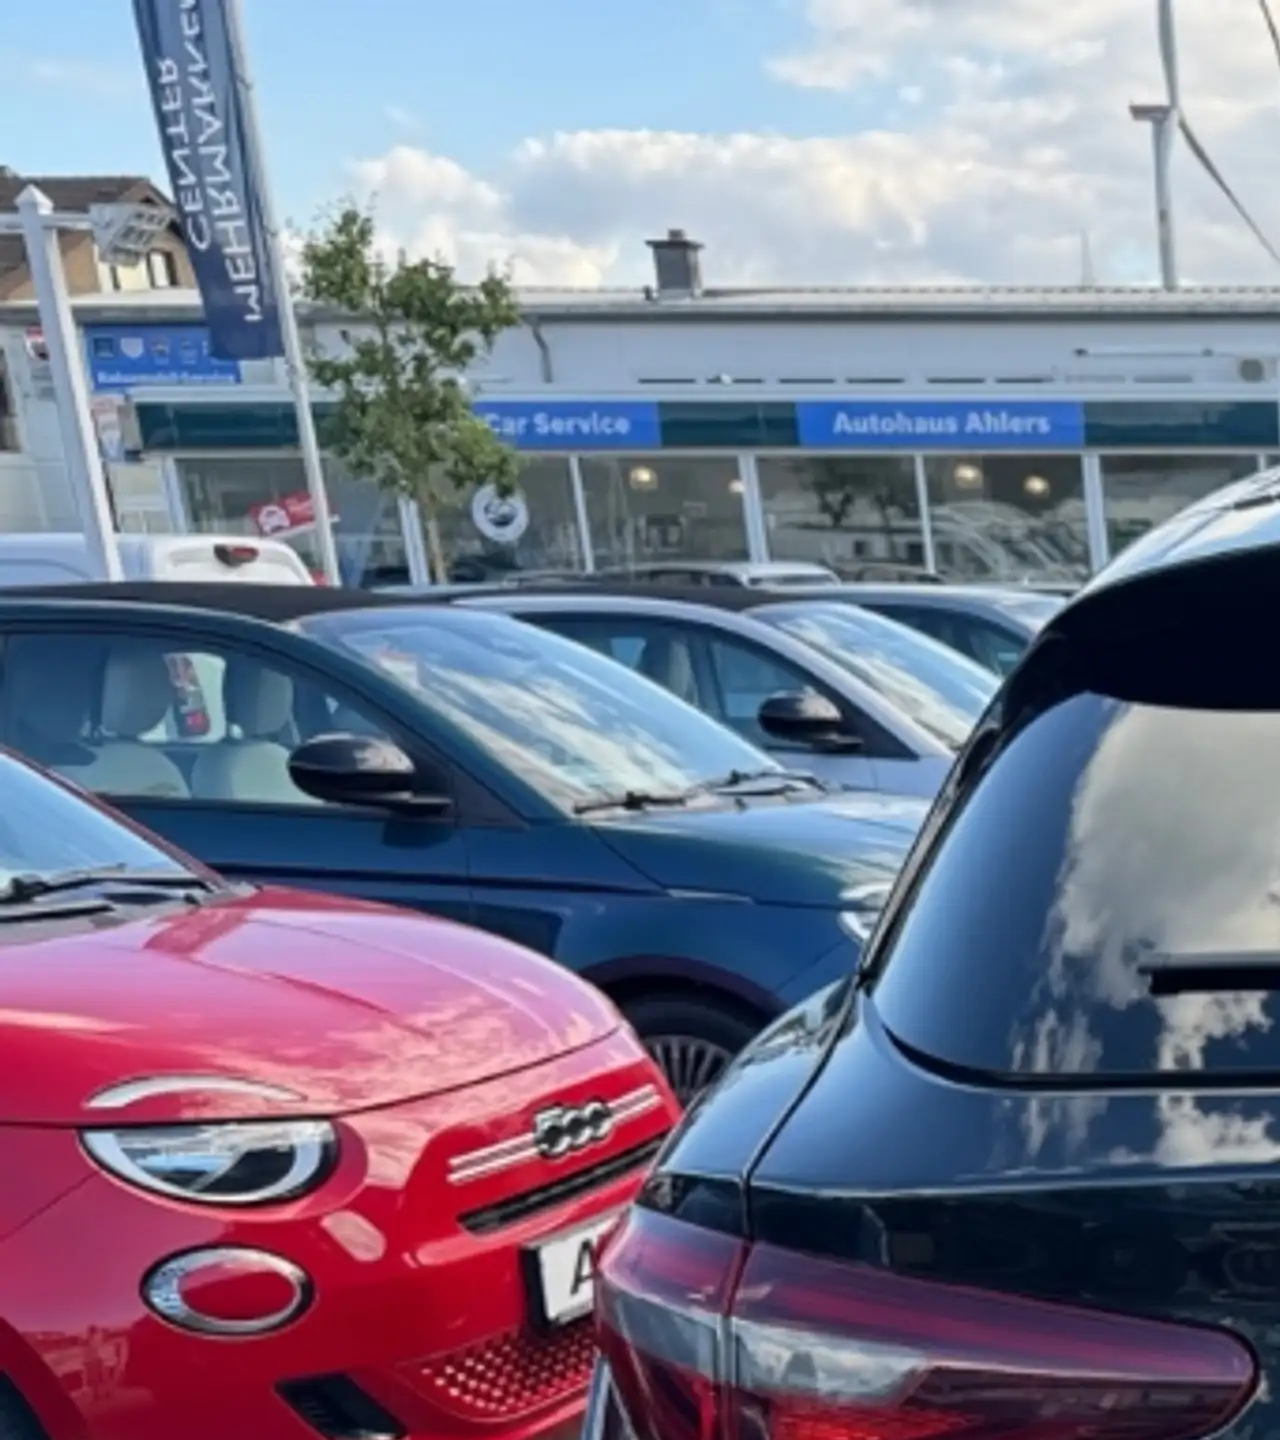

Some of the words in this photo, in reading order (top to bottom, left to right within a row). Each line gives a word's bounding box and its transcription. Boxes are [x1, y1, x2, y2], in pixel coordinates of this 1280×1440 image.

[484, 413, 527, 436] Car
[533, 412, 632, 436] Service
[833, 410, 958, 435] Autohaus
[963, 410, 1052, 435] Ahlers
